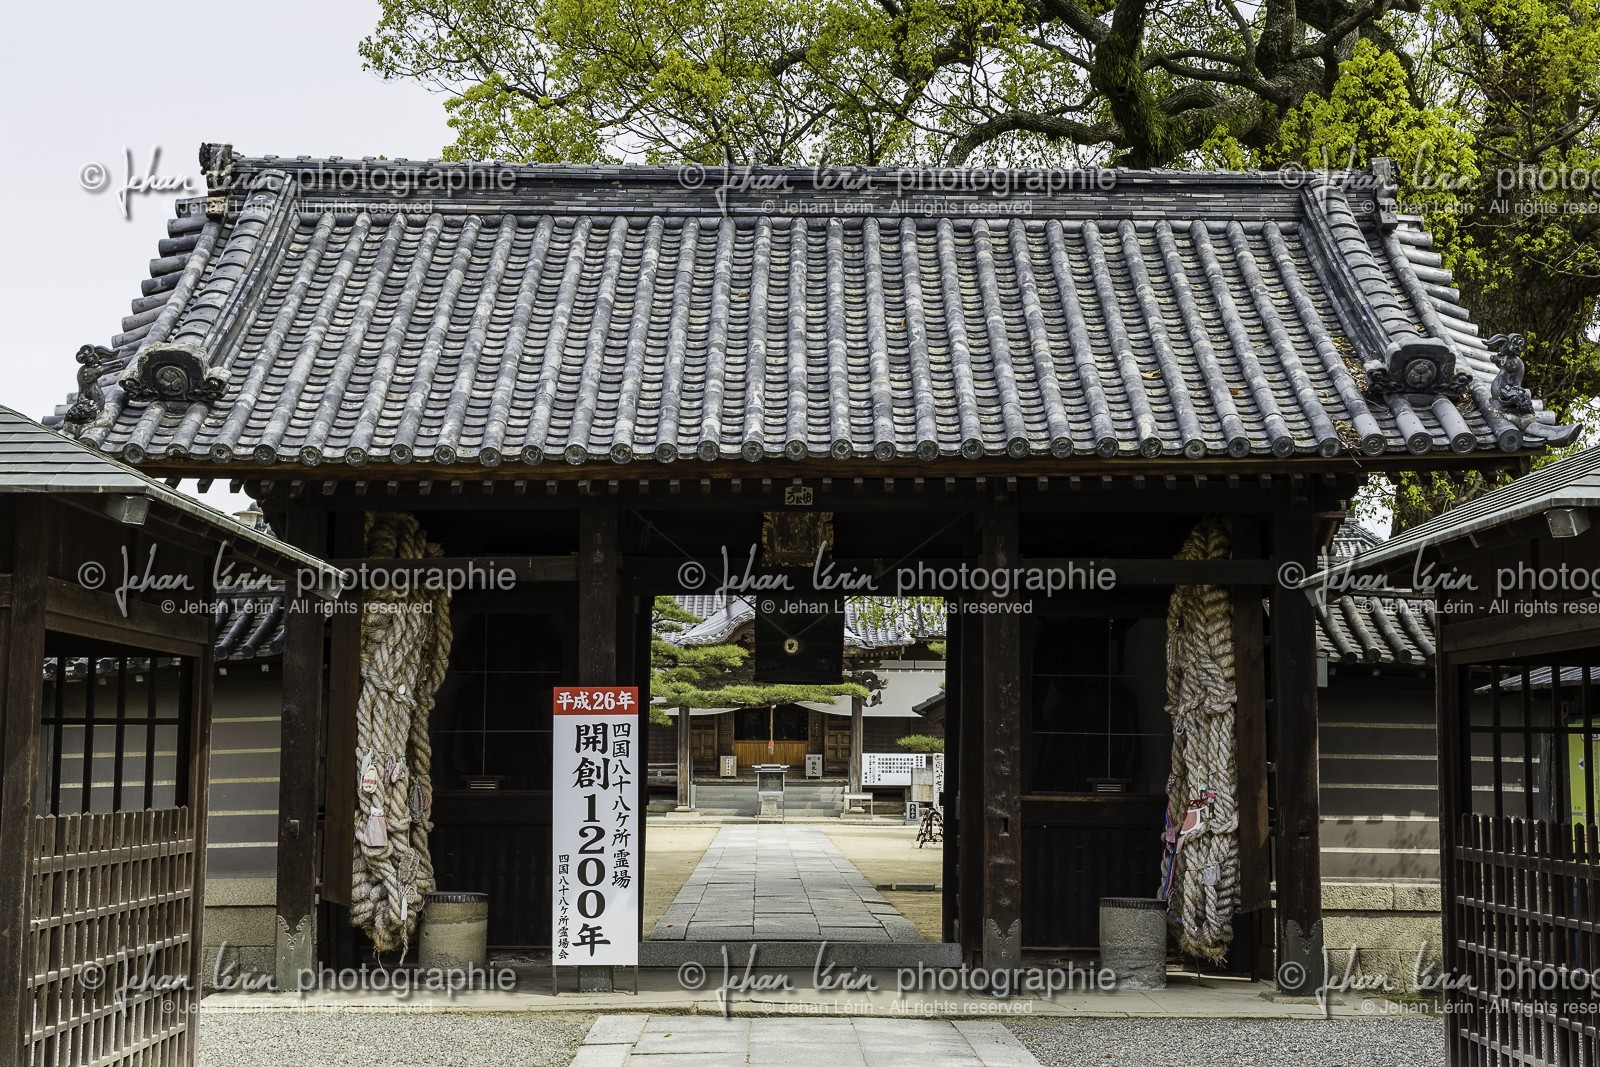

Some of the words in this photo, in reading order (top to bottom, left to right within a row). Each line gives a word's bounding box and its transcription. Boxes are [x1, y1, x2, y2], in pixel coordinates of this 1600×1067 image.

[556, 690, 635, 711] 平成26年
[571, 722, 612, 957] 開創1200年
